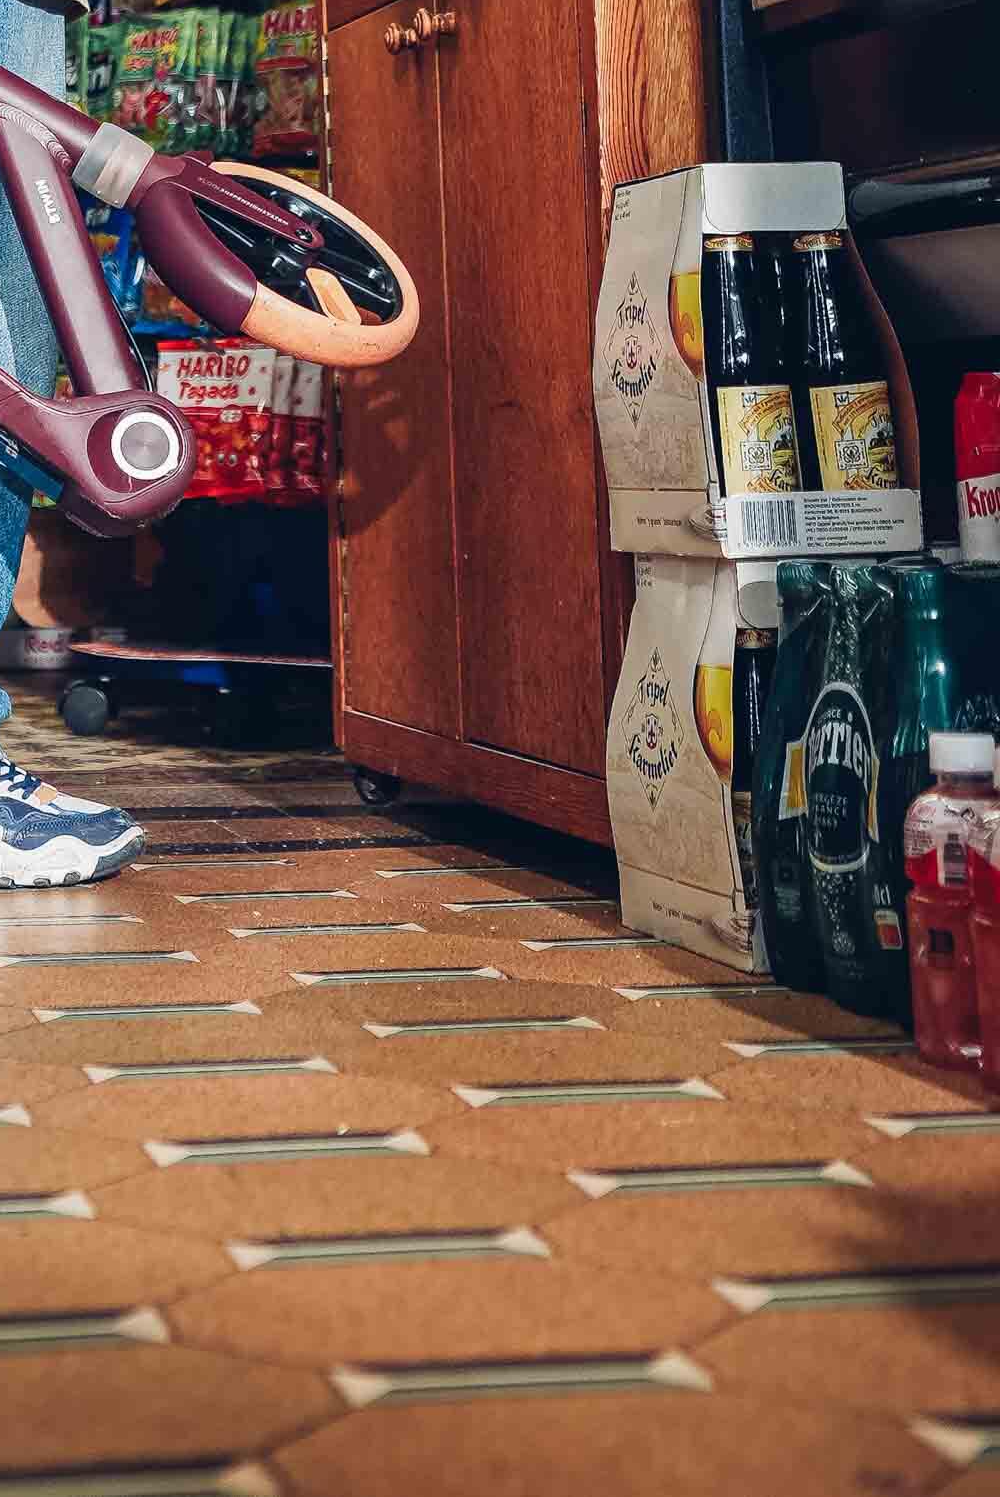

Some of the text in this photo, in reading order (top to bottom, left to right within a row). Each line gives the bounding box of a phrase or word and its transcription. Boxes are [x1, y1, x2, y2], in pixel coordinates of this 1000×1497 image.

[616, 297, 648, 329] Tripel
[176, 354, 250, 379] HARIBO
[611, 356, 657, 398] Karmeliet
[637, 673, 671, 707] Tripel
[628, 734, 677, 780] Karmeliet
[808, 712, 871, 795] errier
